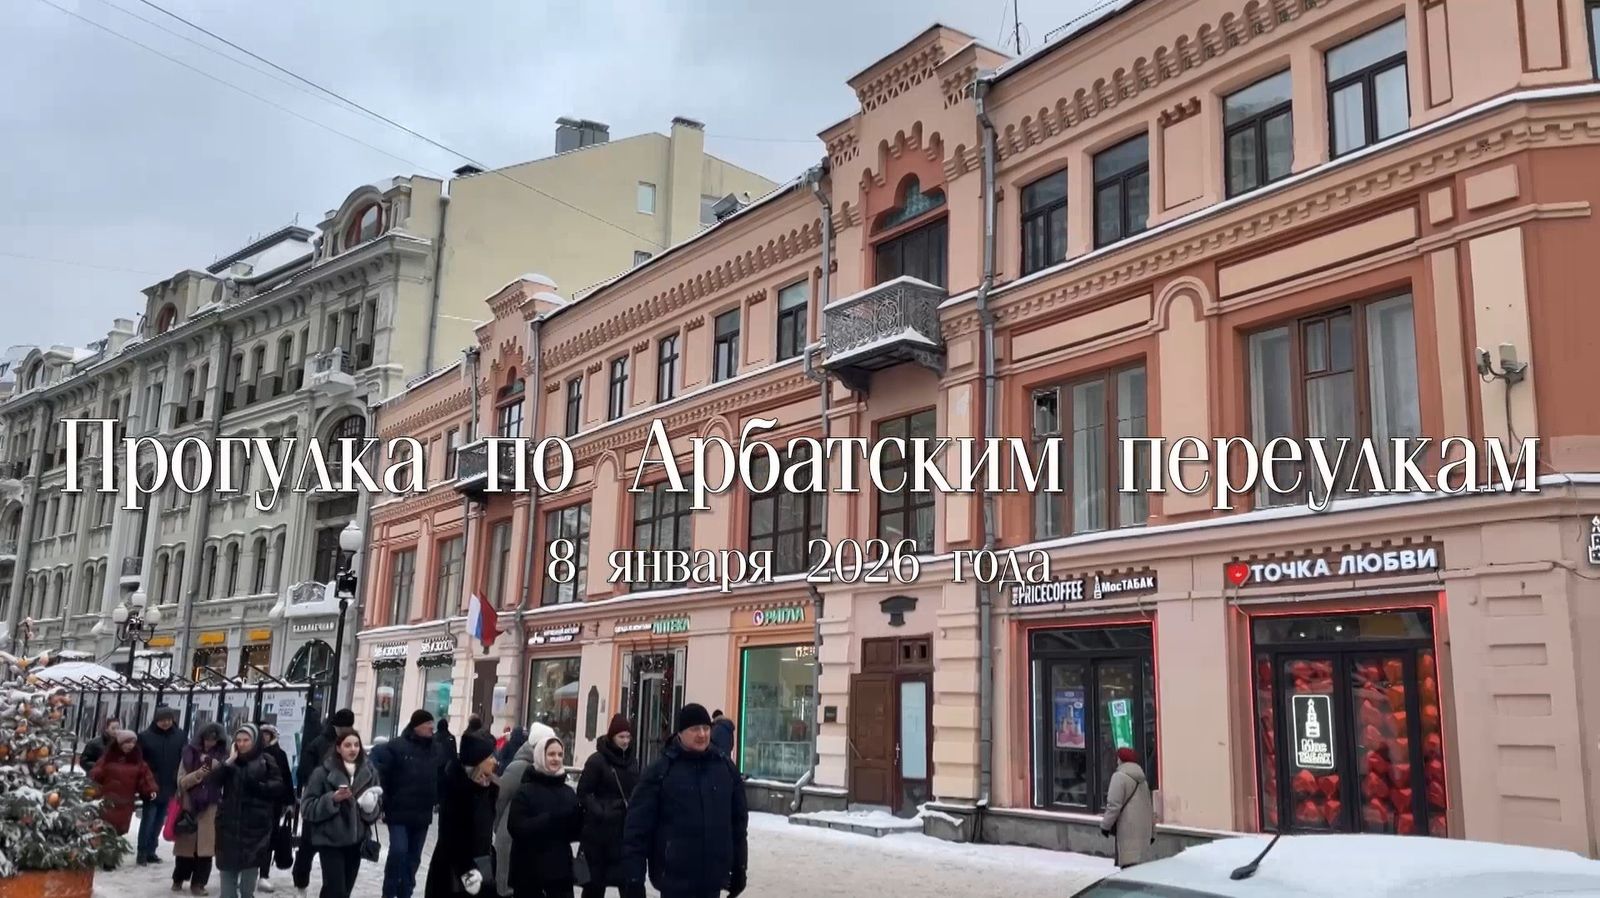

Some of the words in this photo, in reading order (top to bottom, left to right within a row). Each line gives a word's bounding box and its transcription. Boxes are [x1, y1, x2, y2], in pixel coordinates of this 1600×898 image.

[1251, 559, 1332, 582] ТОЧКА
[1339, 548, 1437, 575] ЛЮБВИ
[652, 617, 690, 634] АПТЕКА
